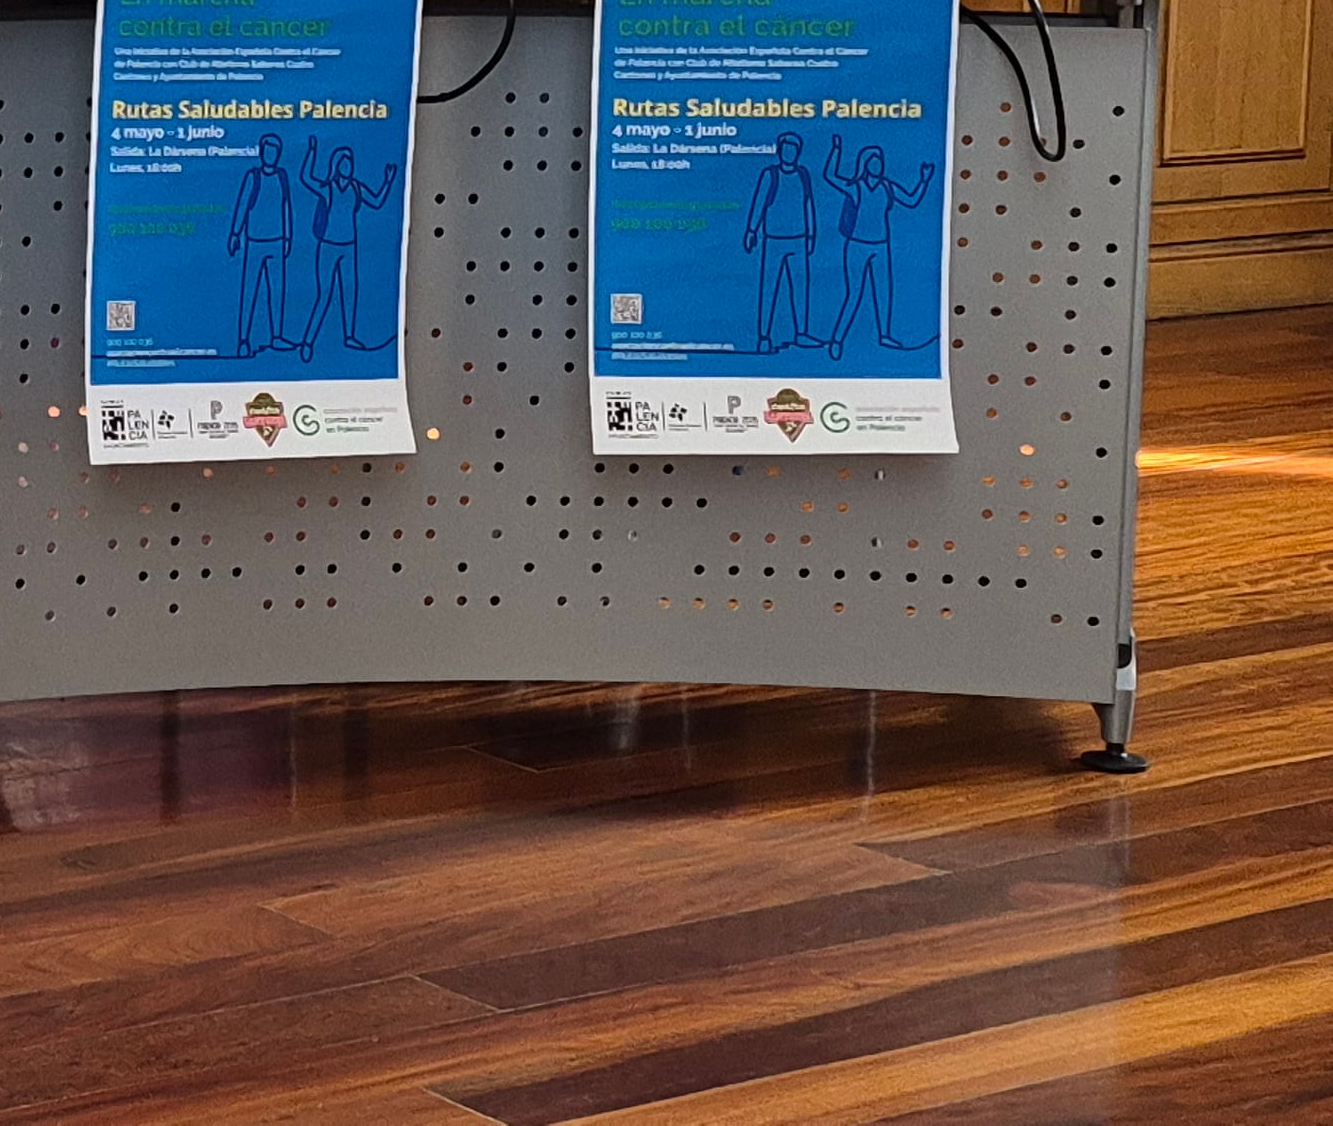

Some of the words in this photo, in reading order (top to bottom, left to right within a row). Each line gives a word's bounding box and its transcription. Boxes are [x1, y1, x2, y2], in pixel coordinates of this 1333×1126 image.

[118, 18, 203, 38] contra
[208, 14, 233, 37] el
[618, 18, 710, 37] contra
[718, 14, 745, 37] el
[754, 14, 856, 37] cáncer
[111, 99, 174, 120] Rutas
[178, 99, 294, 120] Saludables
[298, 98, 388, 120] Palencia
[612, 99, 680, 118] Rutas
[685, 98, 816, 118] Saludables
[821, 98, 923, 118] Palencia
[111, 127, 122, 140] 4
[123, 127, 165, 142] mayo
[176, 127, 186, 139] 1
[186, 124, 225, 142] junio
[611, 124, 623, 138] 4
[625, 124, 671, 139] mayo
[684, 124, 694, 136] 1
[694, 121, 738, 139] junio
[652, 143, 668, 154] La
[127, 419, 150, 431] LEN
[636, 411, 659, 422] LEN
[636, 421, 658, 432] CIA
